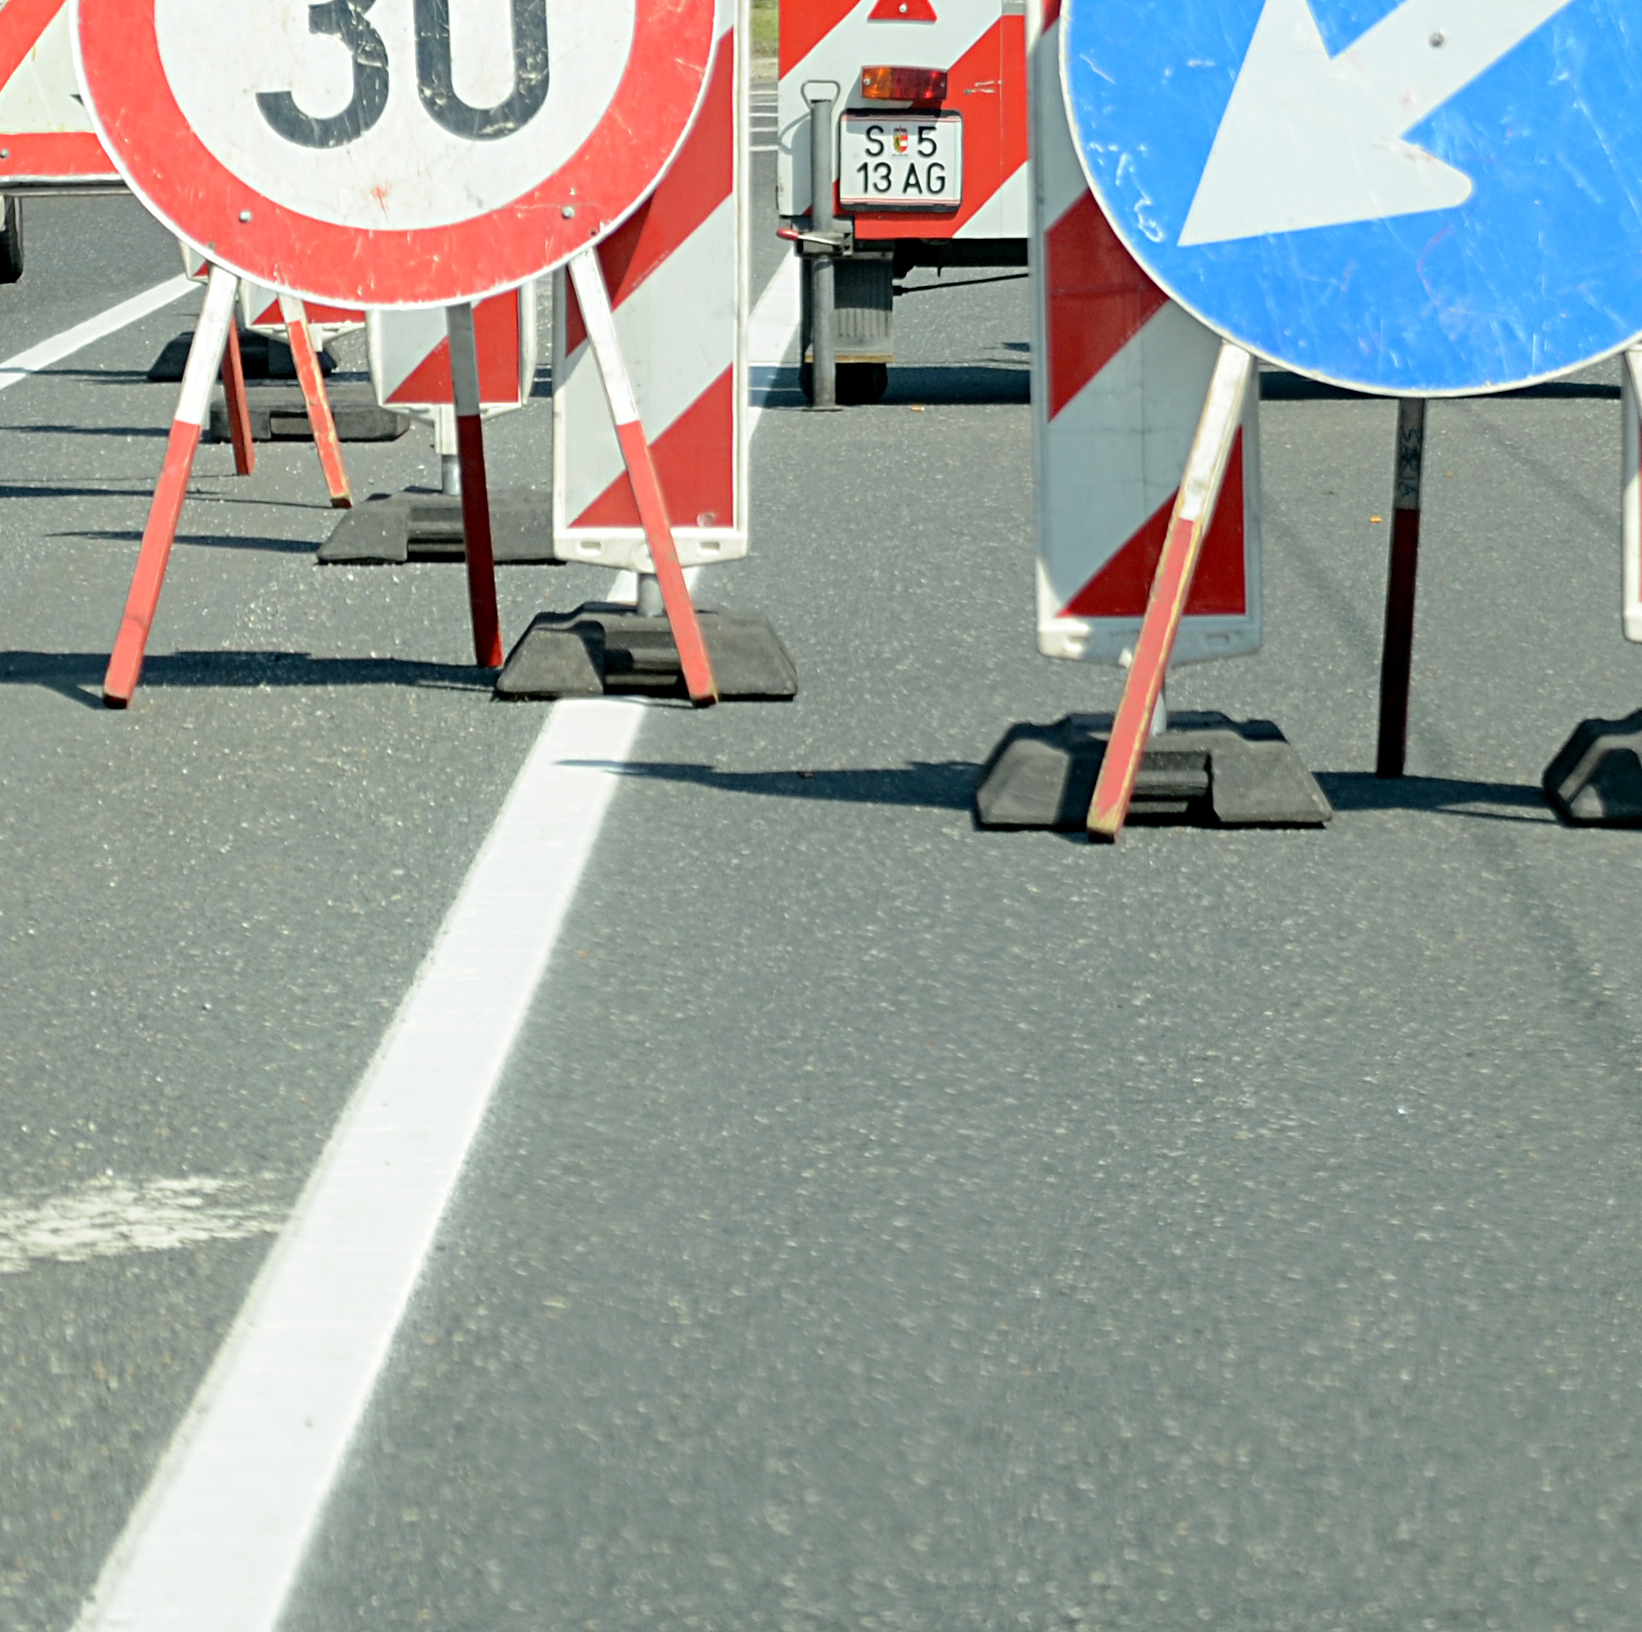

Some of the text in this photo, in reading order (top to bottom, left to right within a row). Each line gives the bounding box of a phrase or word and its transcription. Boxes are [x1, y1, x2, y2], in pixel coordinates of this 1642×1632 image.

[865, 125, 937, 158] S 5
[856, 161, 946, 194] 13 AG
